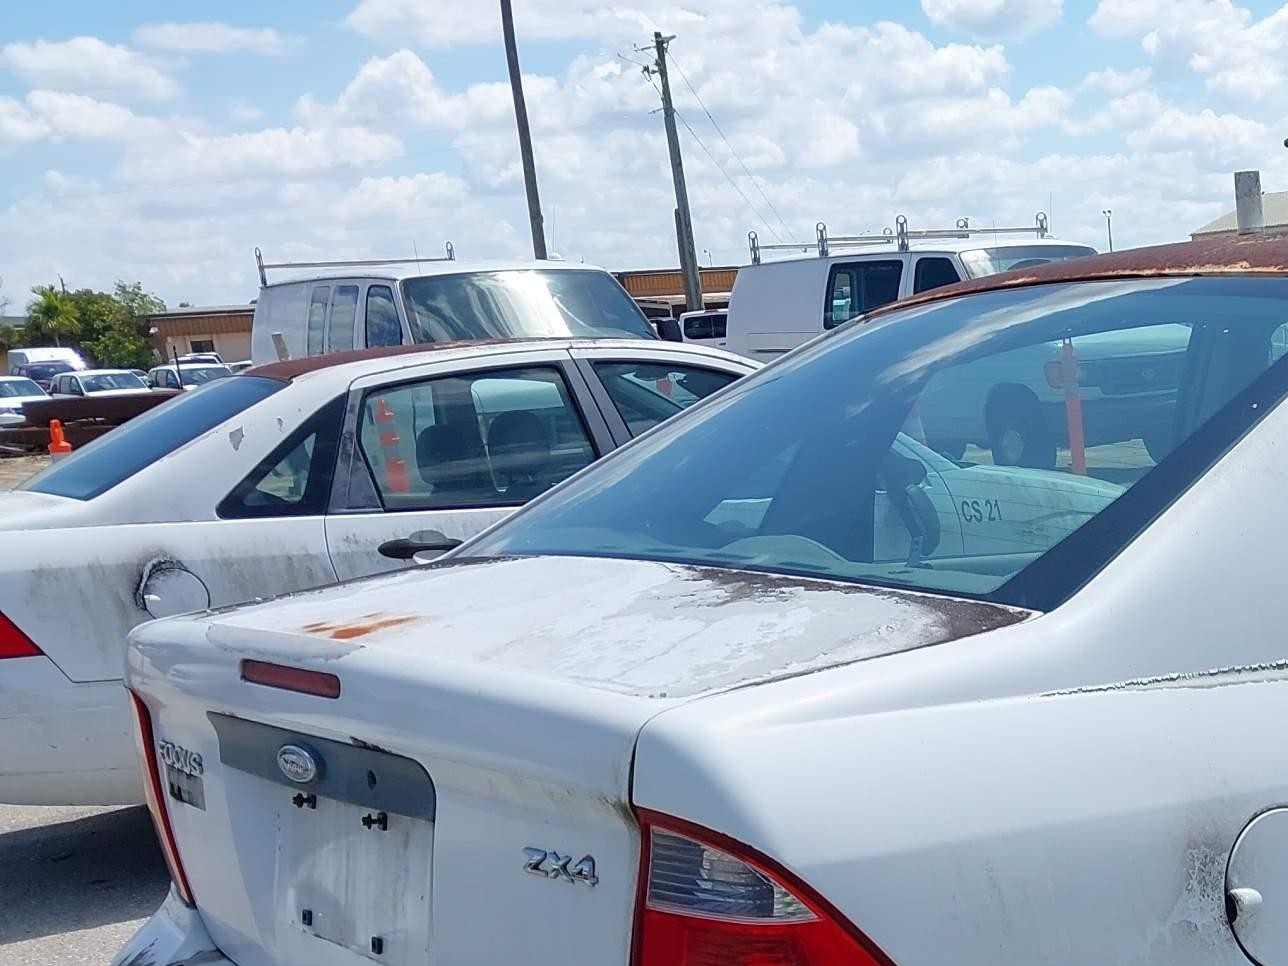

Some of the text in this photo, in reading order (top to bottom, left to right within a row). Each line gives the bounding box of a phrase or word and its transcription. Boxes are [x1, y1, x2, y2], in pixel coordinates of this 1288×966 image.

[961, 499, 1002, 523] CS 21
[522, 846, 600, 887] ZX4
